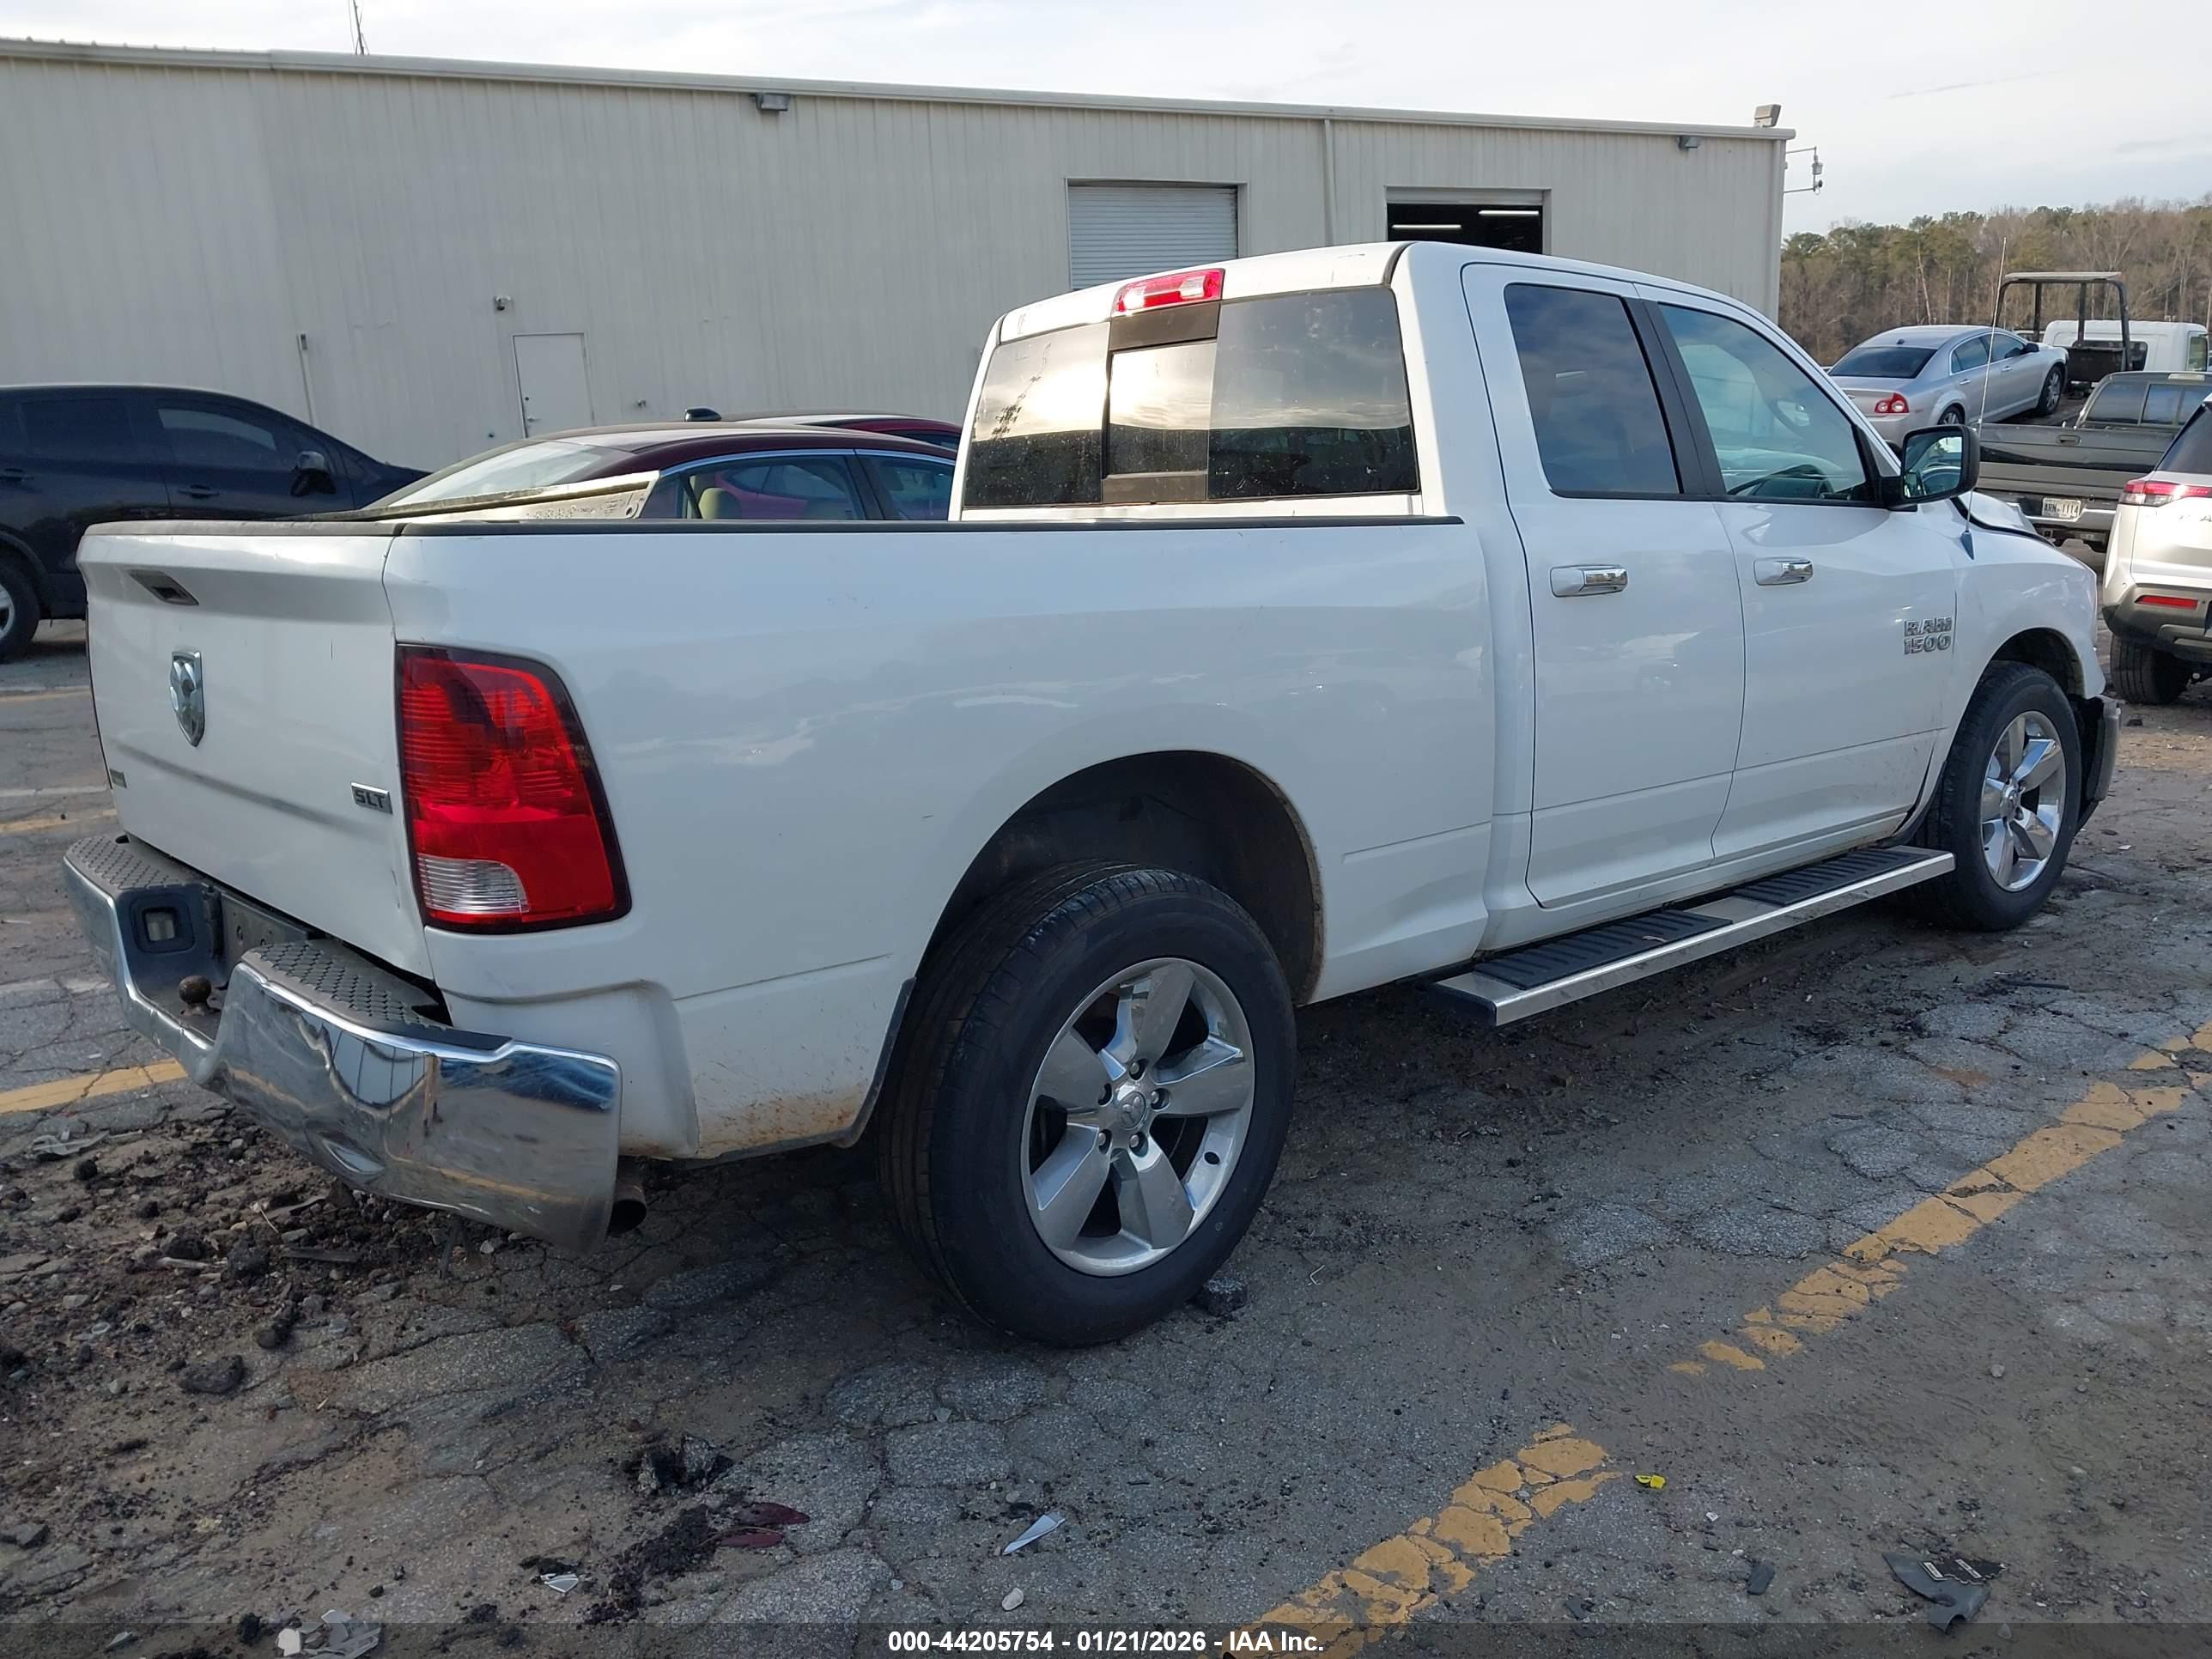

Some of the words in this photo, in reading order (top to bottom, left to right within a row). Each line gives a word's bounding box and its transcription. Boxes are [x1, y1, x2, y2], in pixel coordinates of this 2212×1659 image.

[1904, 616, 1952, 636] RAM
[1904, 634, 1952, 655] 1500
[354, 789, 386, 809] SLT
